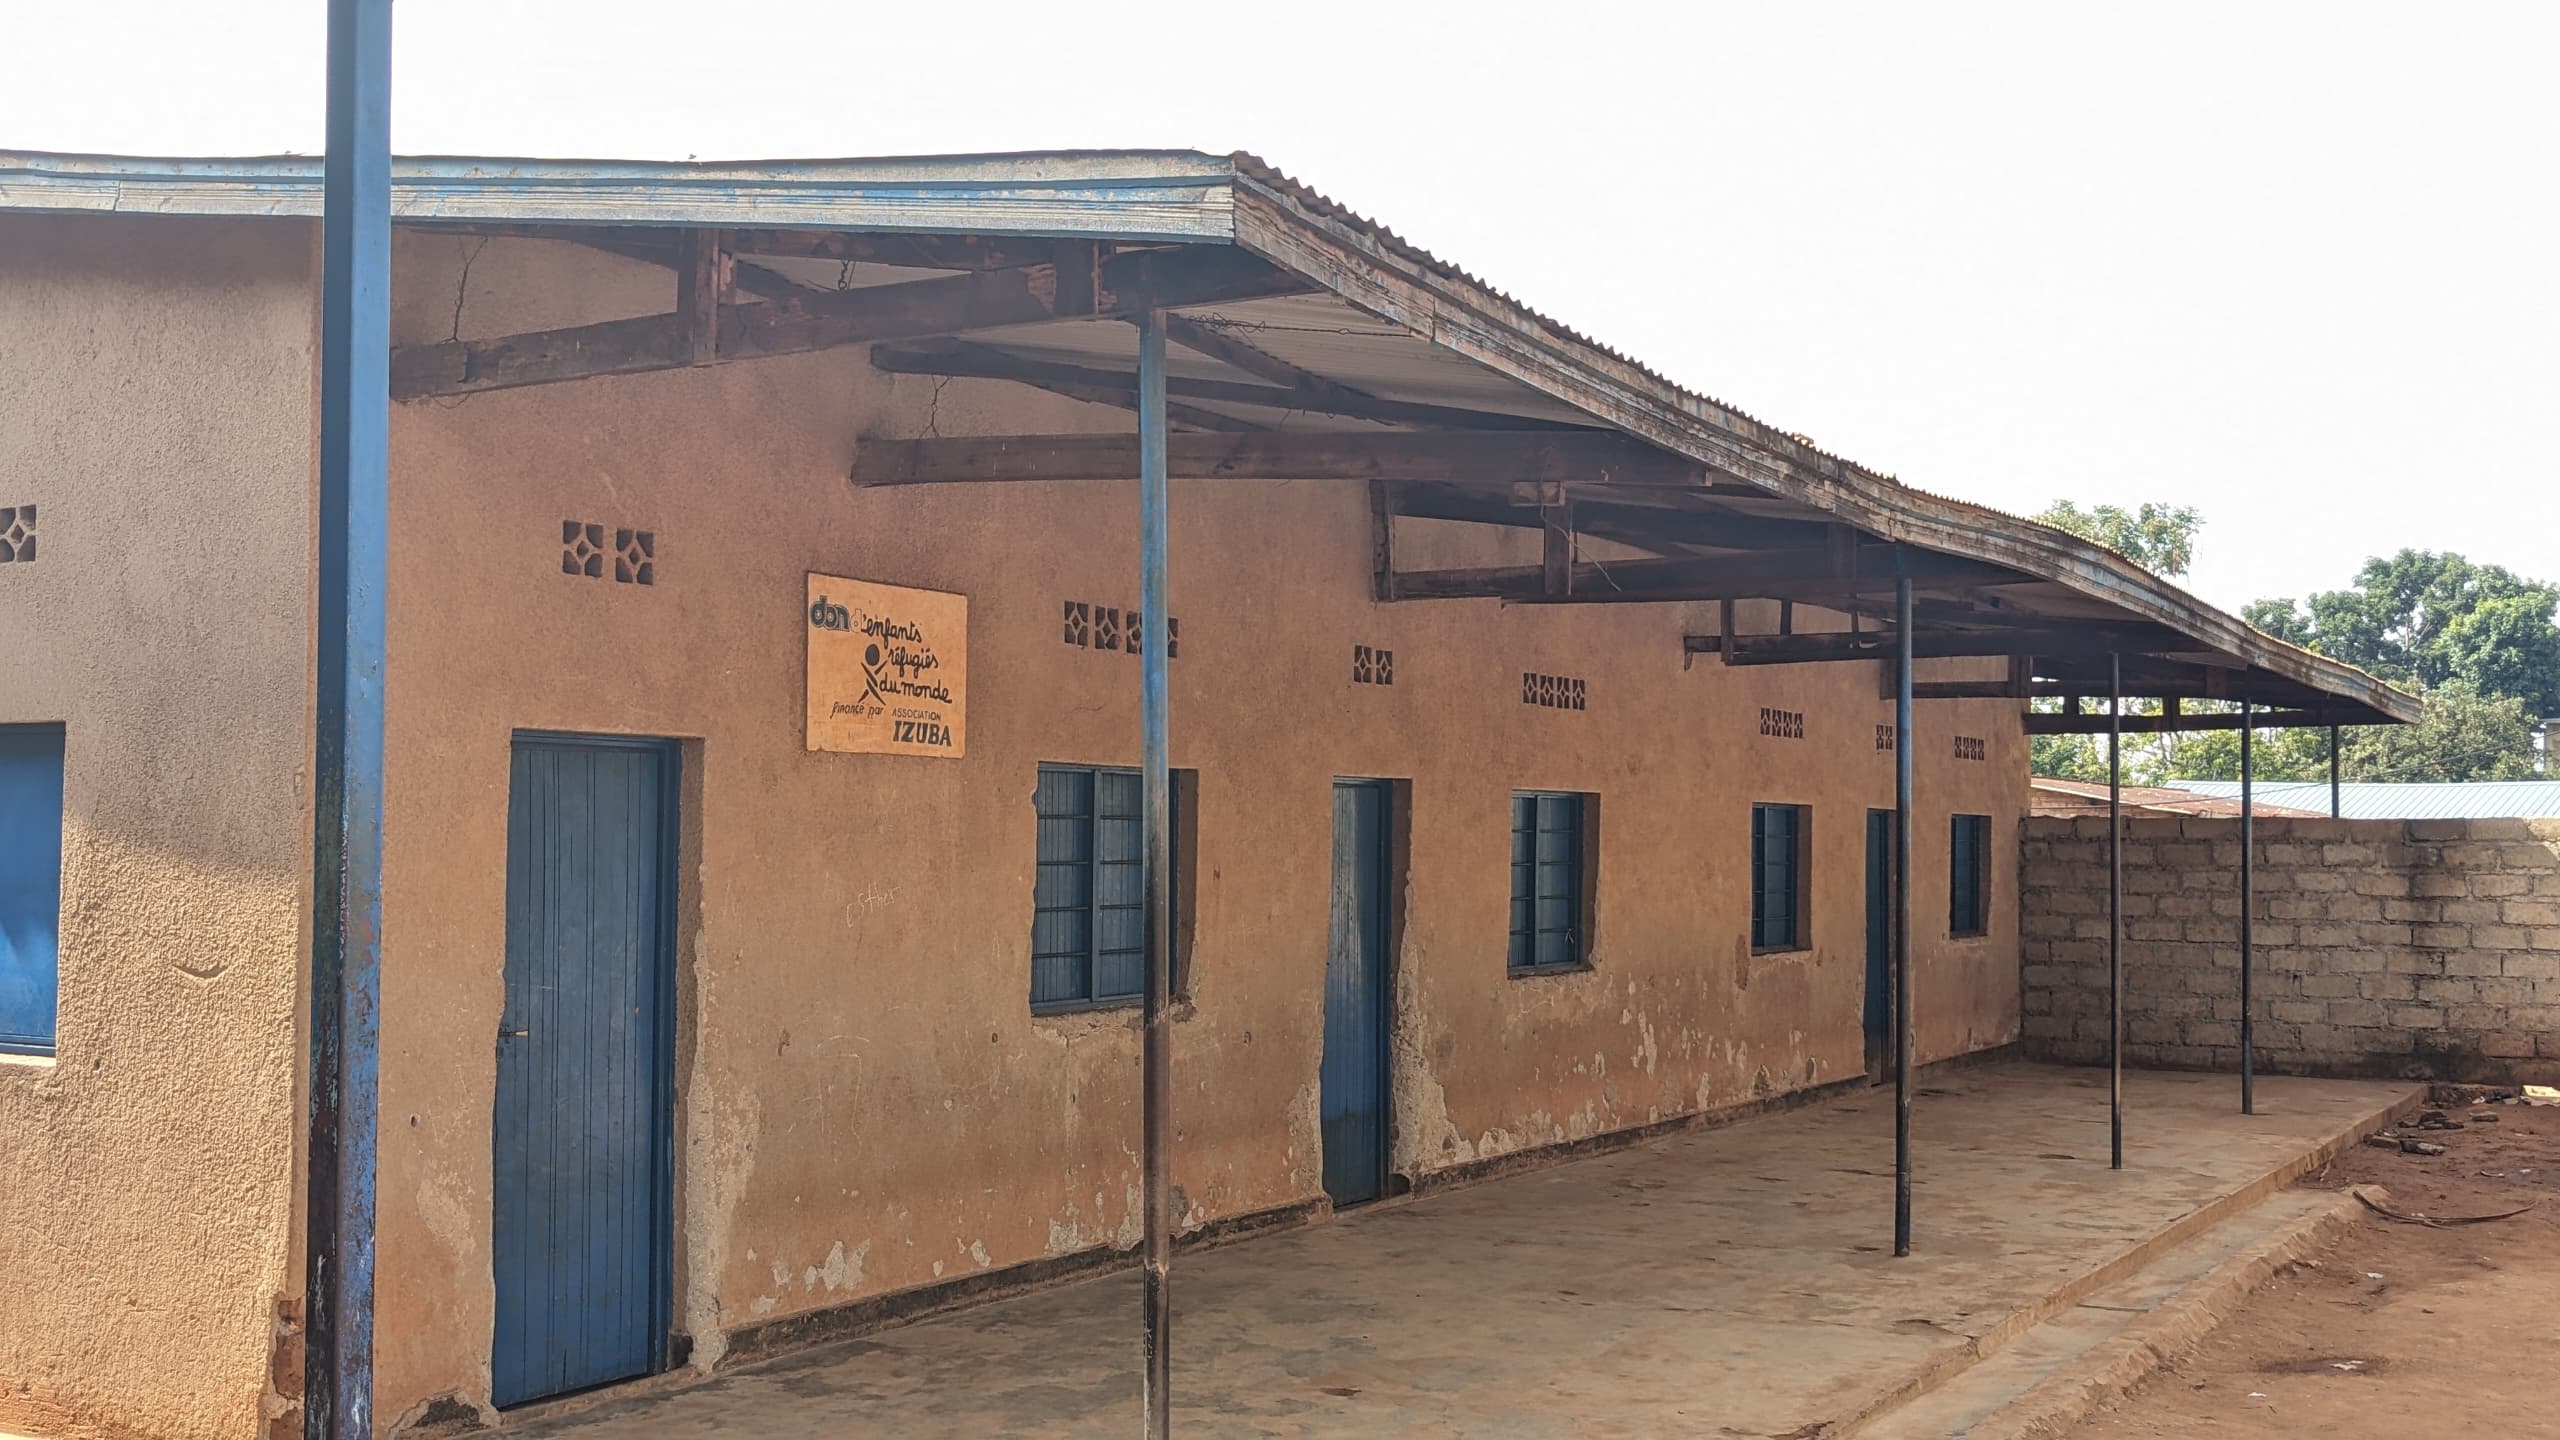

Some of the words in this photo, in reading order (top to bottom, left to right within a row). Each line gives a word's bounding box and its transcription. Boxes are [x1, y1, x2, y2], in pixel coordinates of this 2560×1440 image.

[811, 596, 850, 632] don
[888, 646, 939, 679] réfugiés
[879, 672, 901, 693] du
[901, 679, 953, 704] monde
[867, 706, 884, 719] par
[892, 707, 942, 721] ASSOCIATION
[892, 720, 952, 747] IZUBA
